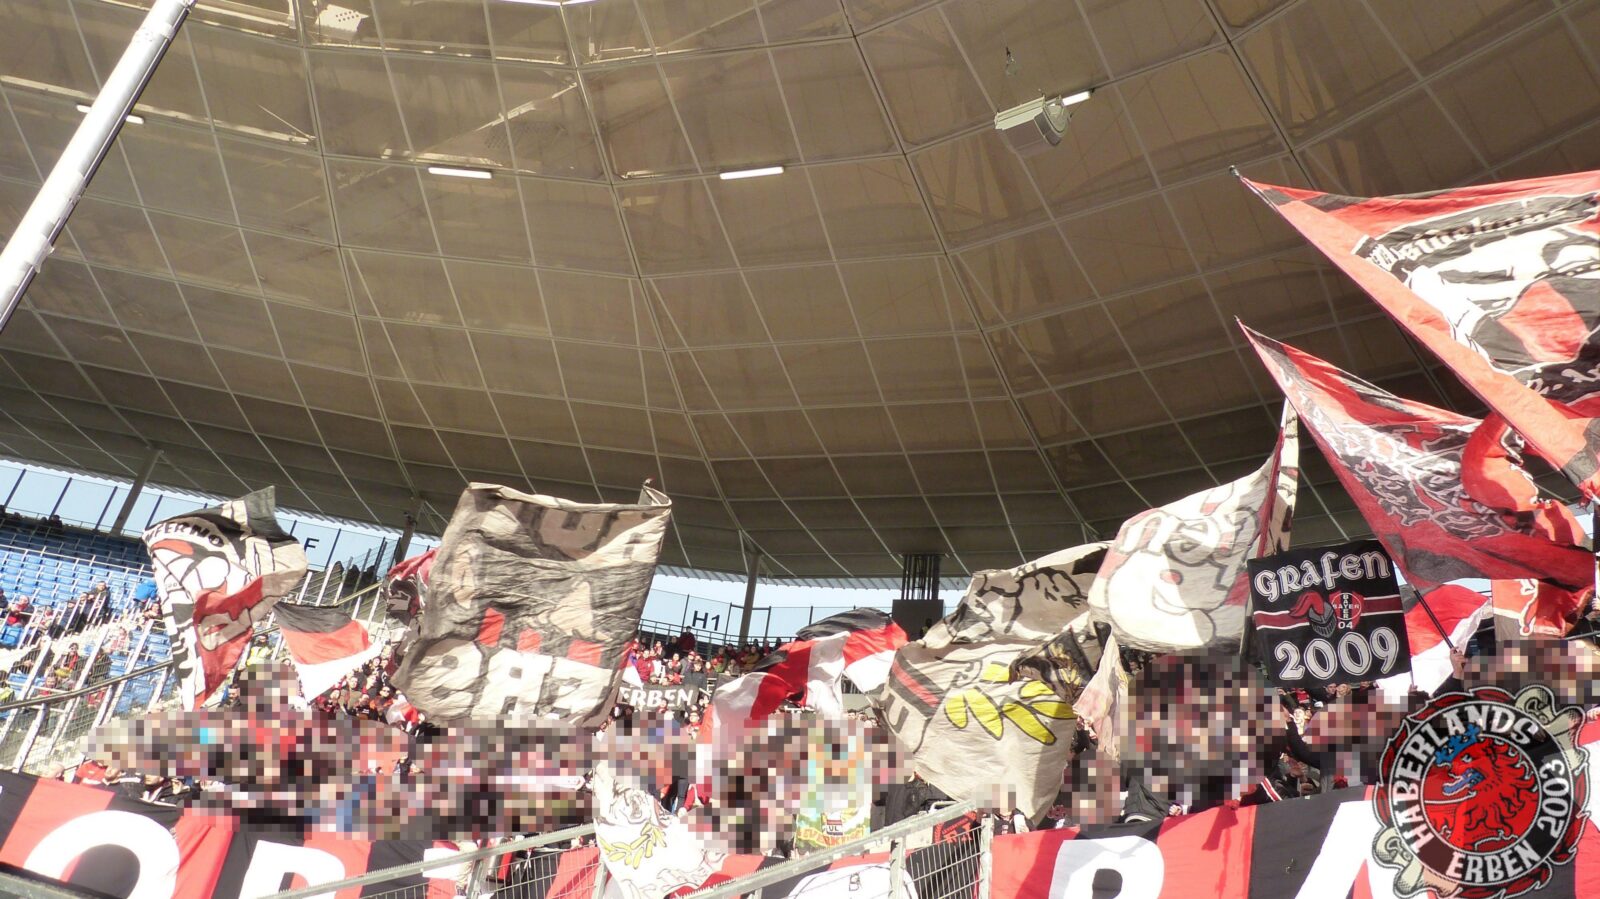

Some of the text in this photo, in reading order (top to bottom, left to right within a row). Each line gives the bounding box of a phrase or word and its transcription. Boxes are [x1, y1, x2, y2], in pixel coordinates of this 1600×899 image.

[145, 521, 224, 547] NFERNO
[692, 610, 720, 631] H1
[1338, 621, 1353, 629] 04
[1274, 627, 1399, 680] 2009
[619, 686, 694, 707] ERBEN
